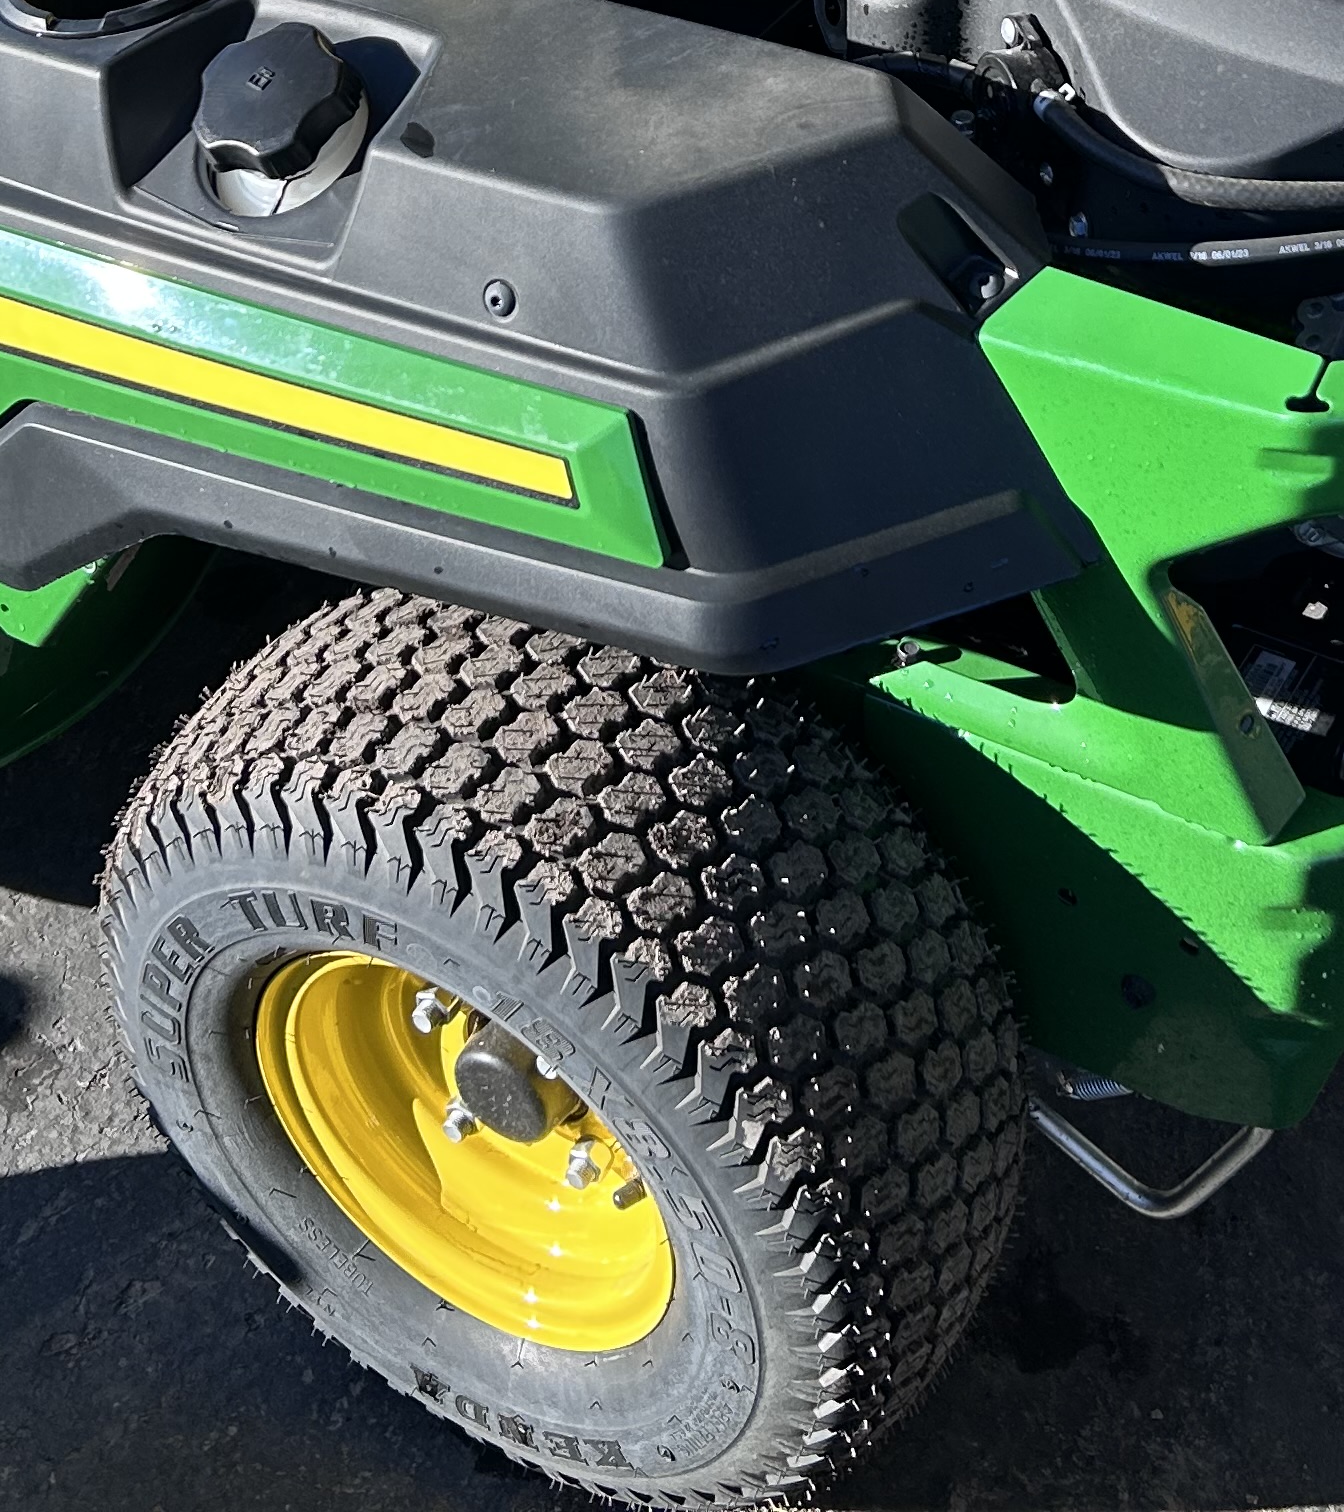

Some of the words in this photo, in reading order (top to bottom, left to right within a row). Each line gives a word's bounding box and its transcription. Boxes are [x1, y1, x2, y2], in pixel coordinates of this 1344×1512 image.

[1278, 242, 1311, 255] AKWEL
[139, 913, 215, 1084] SUPER
[219, 890, 398, 951] TURF
[298, 1216, 375, 1297] TUBELESS
[410, 1363, 635, 1471] KENDA
